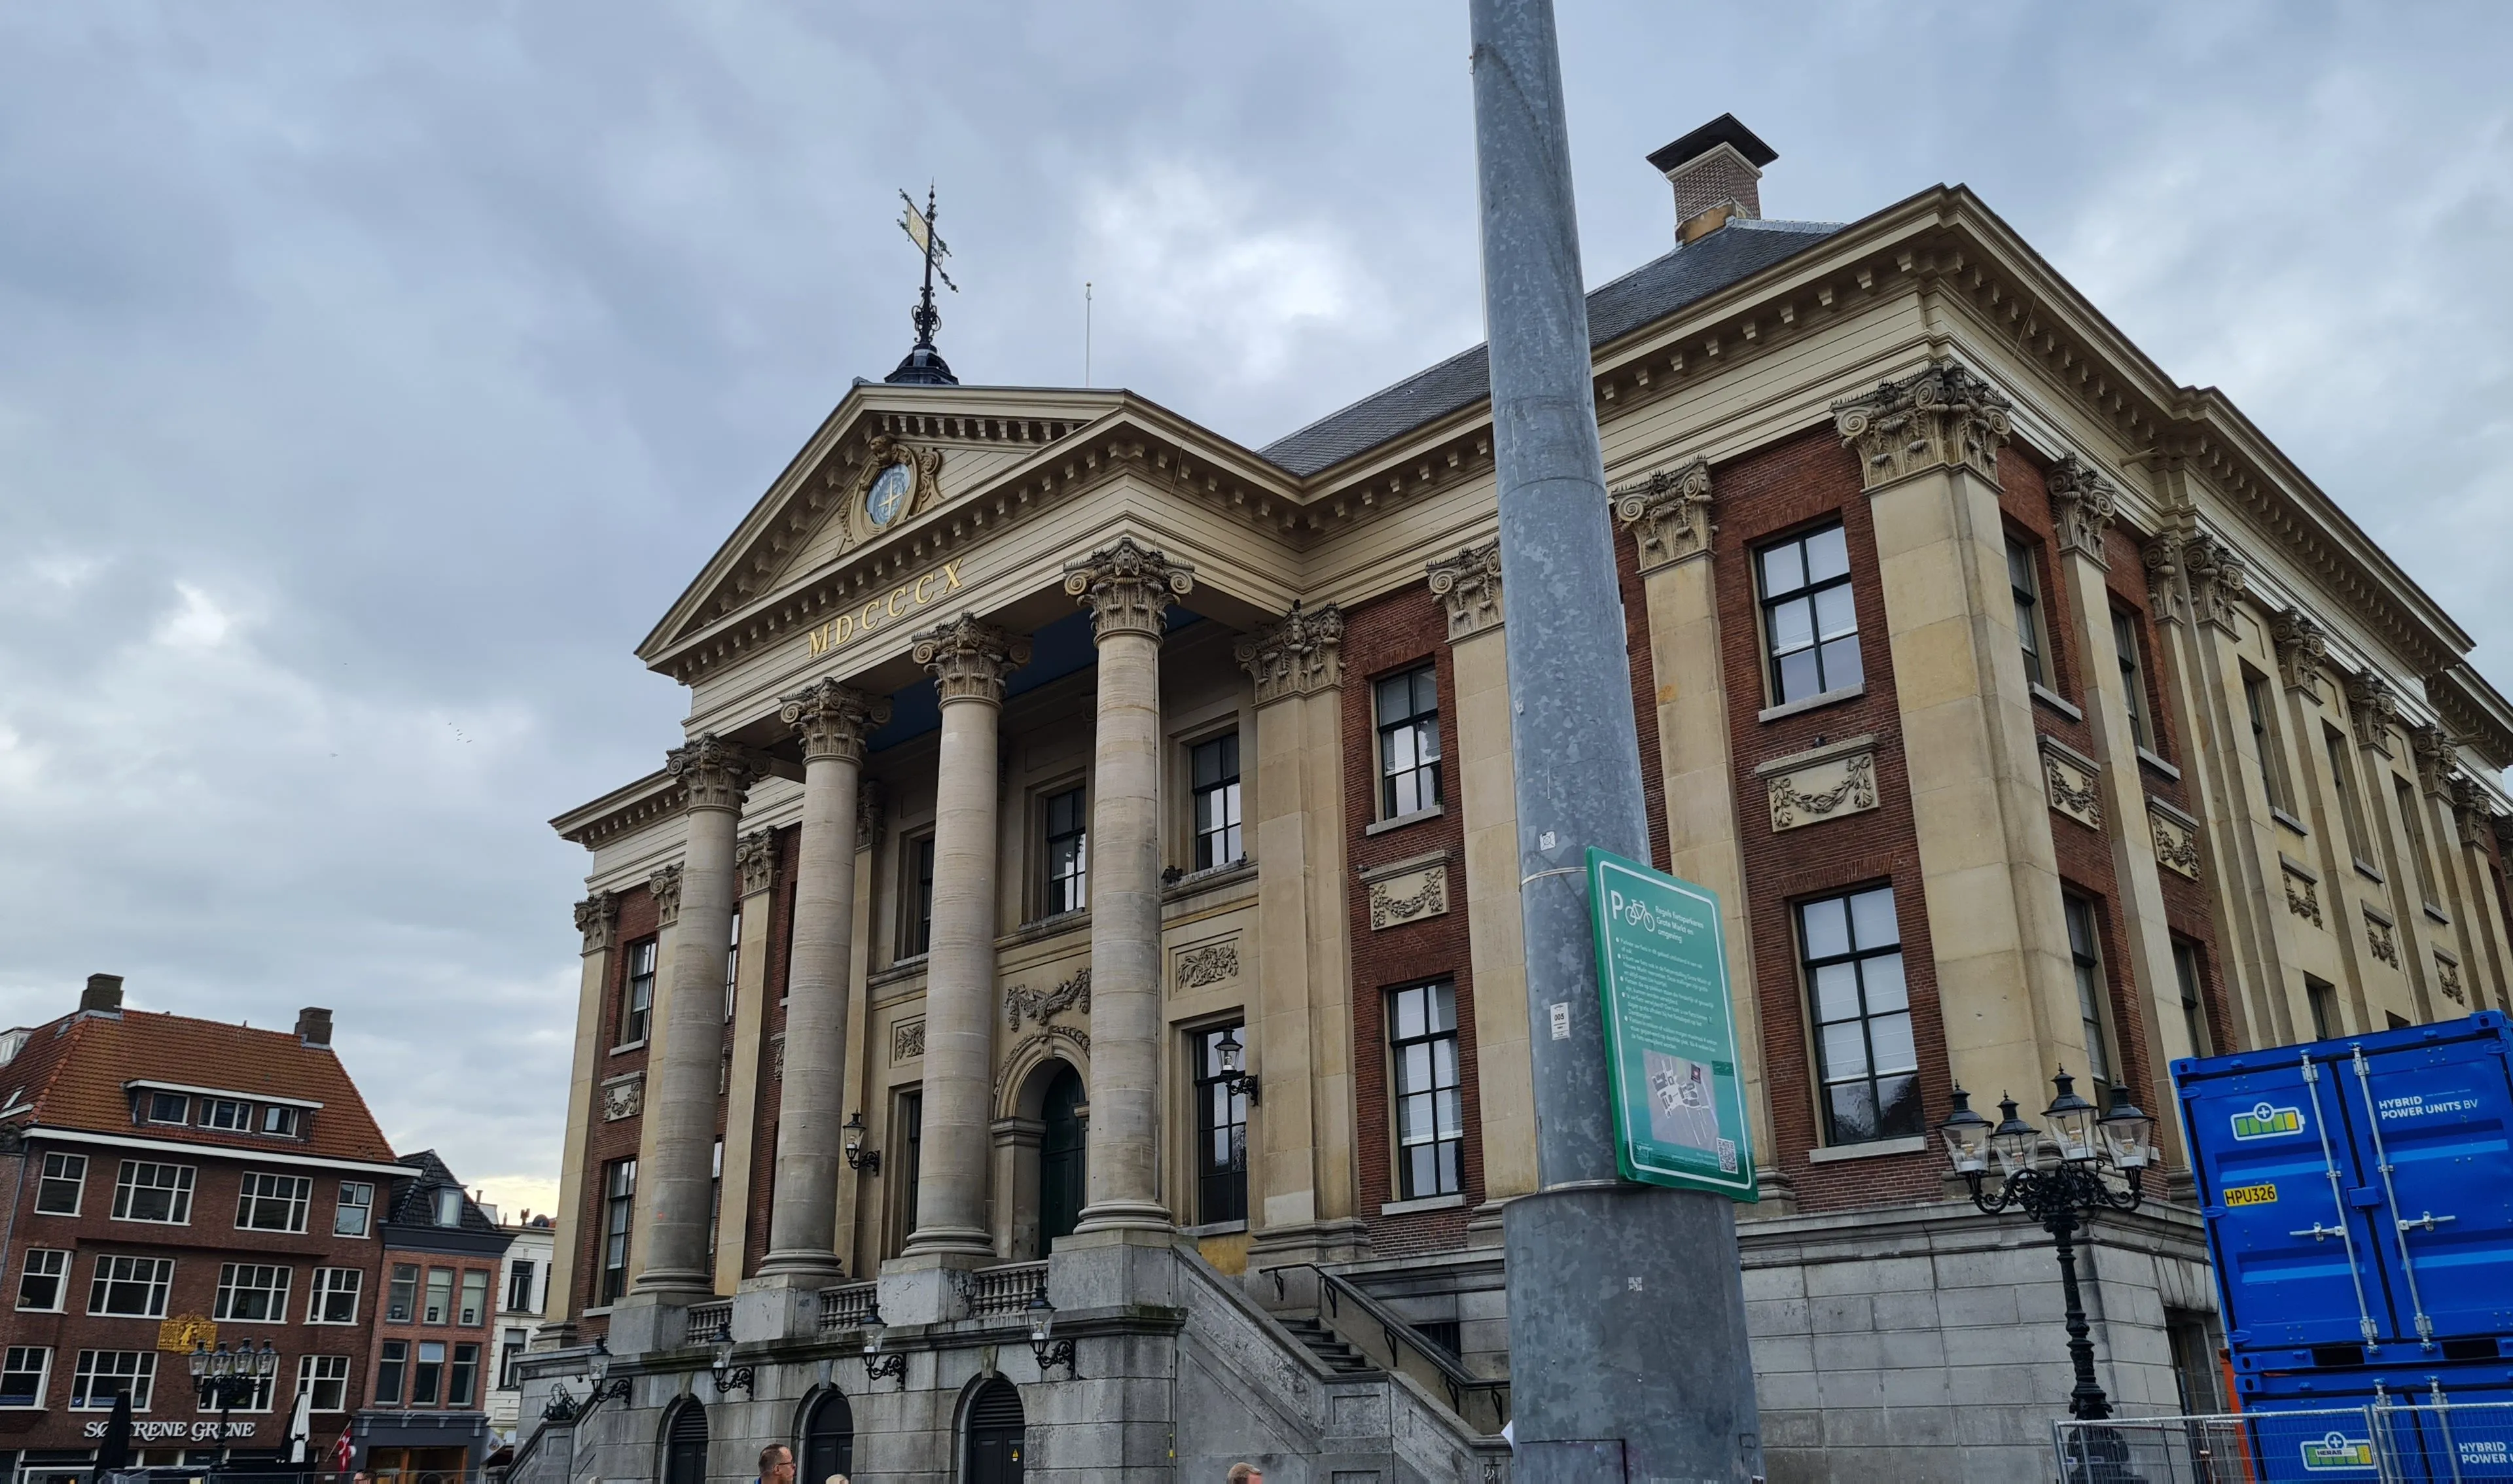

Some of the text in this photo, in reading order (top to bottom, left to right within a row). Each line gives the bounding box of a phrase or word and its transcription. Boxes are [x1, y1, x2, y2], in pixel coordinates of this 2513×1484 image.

[808, 557, 963, 659] MDCCCX
[1610, 889, 1624, 919] P
[1655, 906, 1672, 918] Regels
[1656, 917, 1671, 928] Grote
[1671, 921, 1686, 933] Markt
[1658, 929, 1683, 944] omgeving
[2378, 1096, 2423, 1110] HYBRID
[2381, 1099, 2478, 1120] POWER UNITS BV
[2224, 1186, 2275, 1205] HPU326
[84, 1421, 187, 1441] SØRENE
[2458, 1441, 2506, 1453] HYBRID
[2461, 1453, 2508, 1464] POWER
